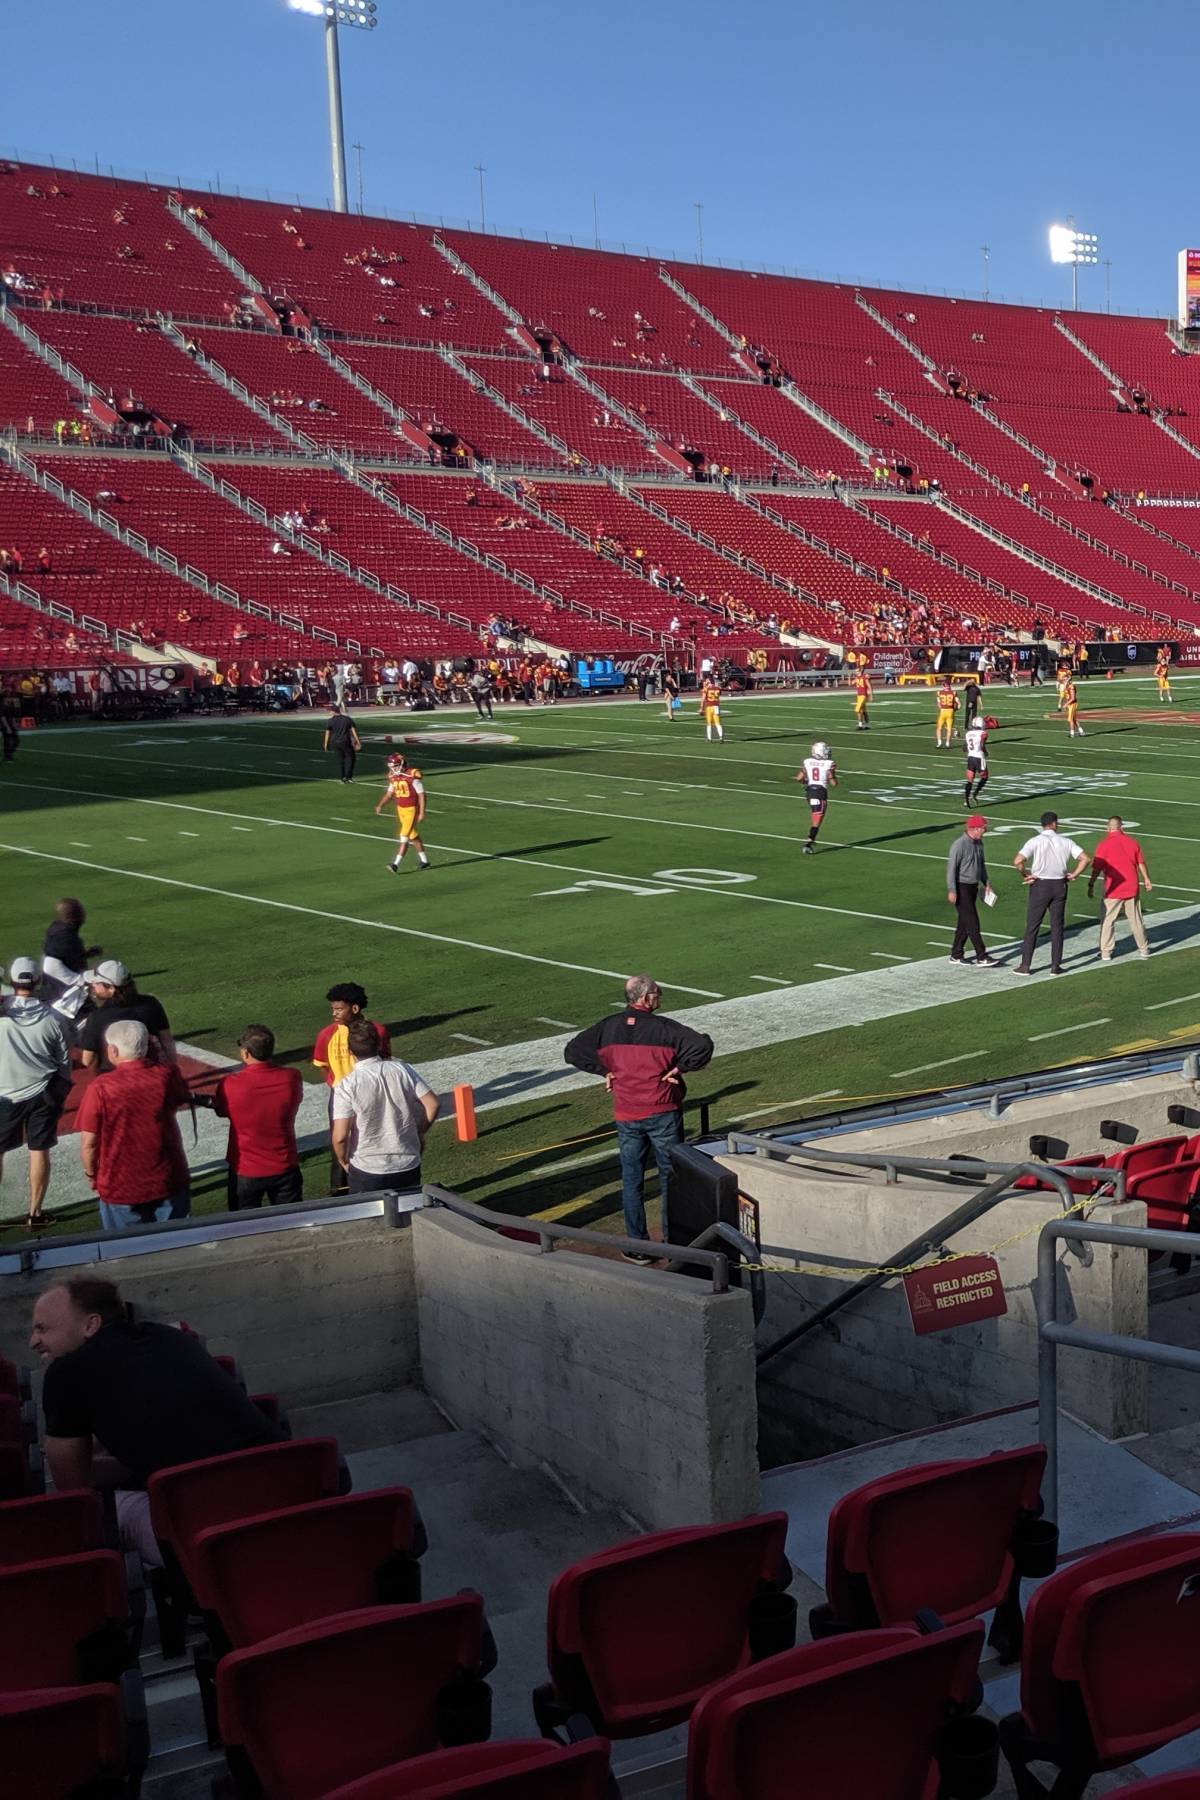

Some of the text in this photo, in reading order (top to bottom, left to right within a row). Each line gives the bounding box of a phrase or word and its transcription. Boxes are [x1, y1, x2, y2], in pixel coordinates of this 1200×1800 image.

[968, 739, 974, 750] 3
[812, 768, 820, 781] 8
[572, 868, 756, 896] 10
[933, 1270, 997, 1294] FIELD ACCESS
[936, 1286, 993, 1309] RESTRICTED
